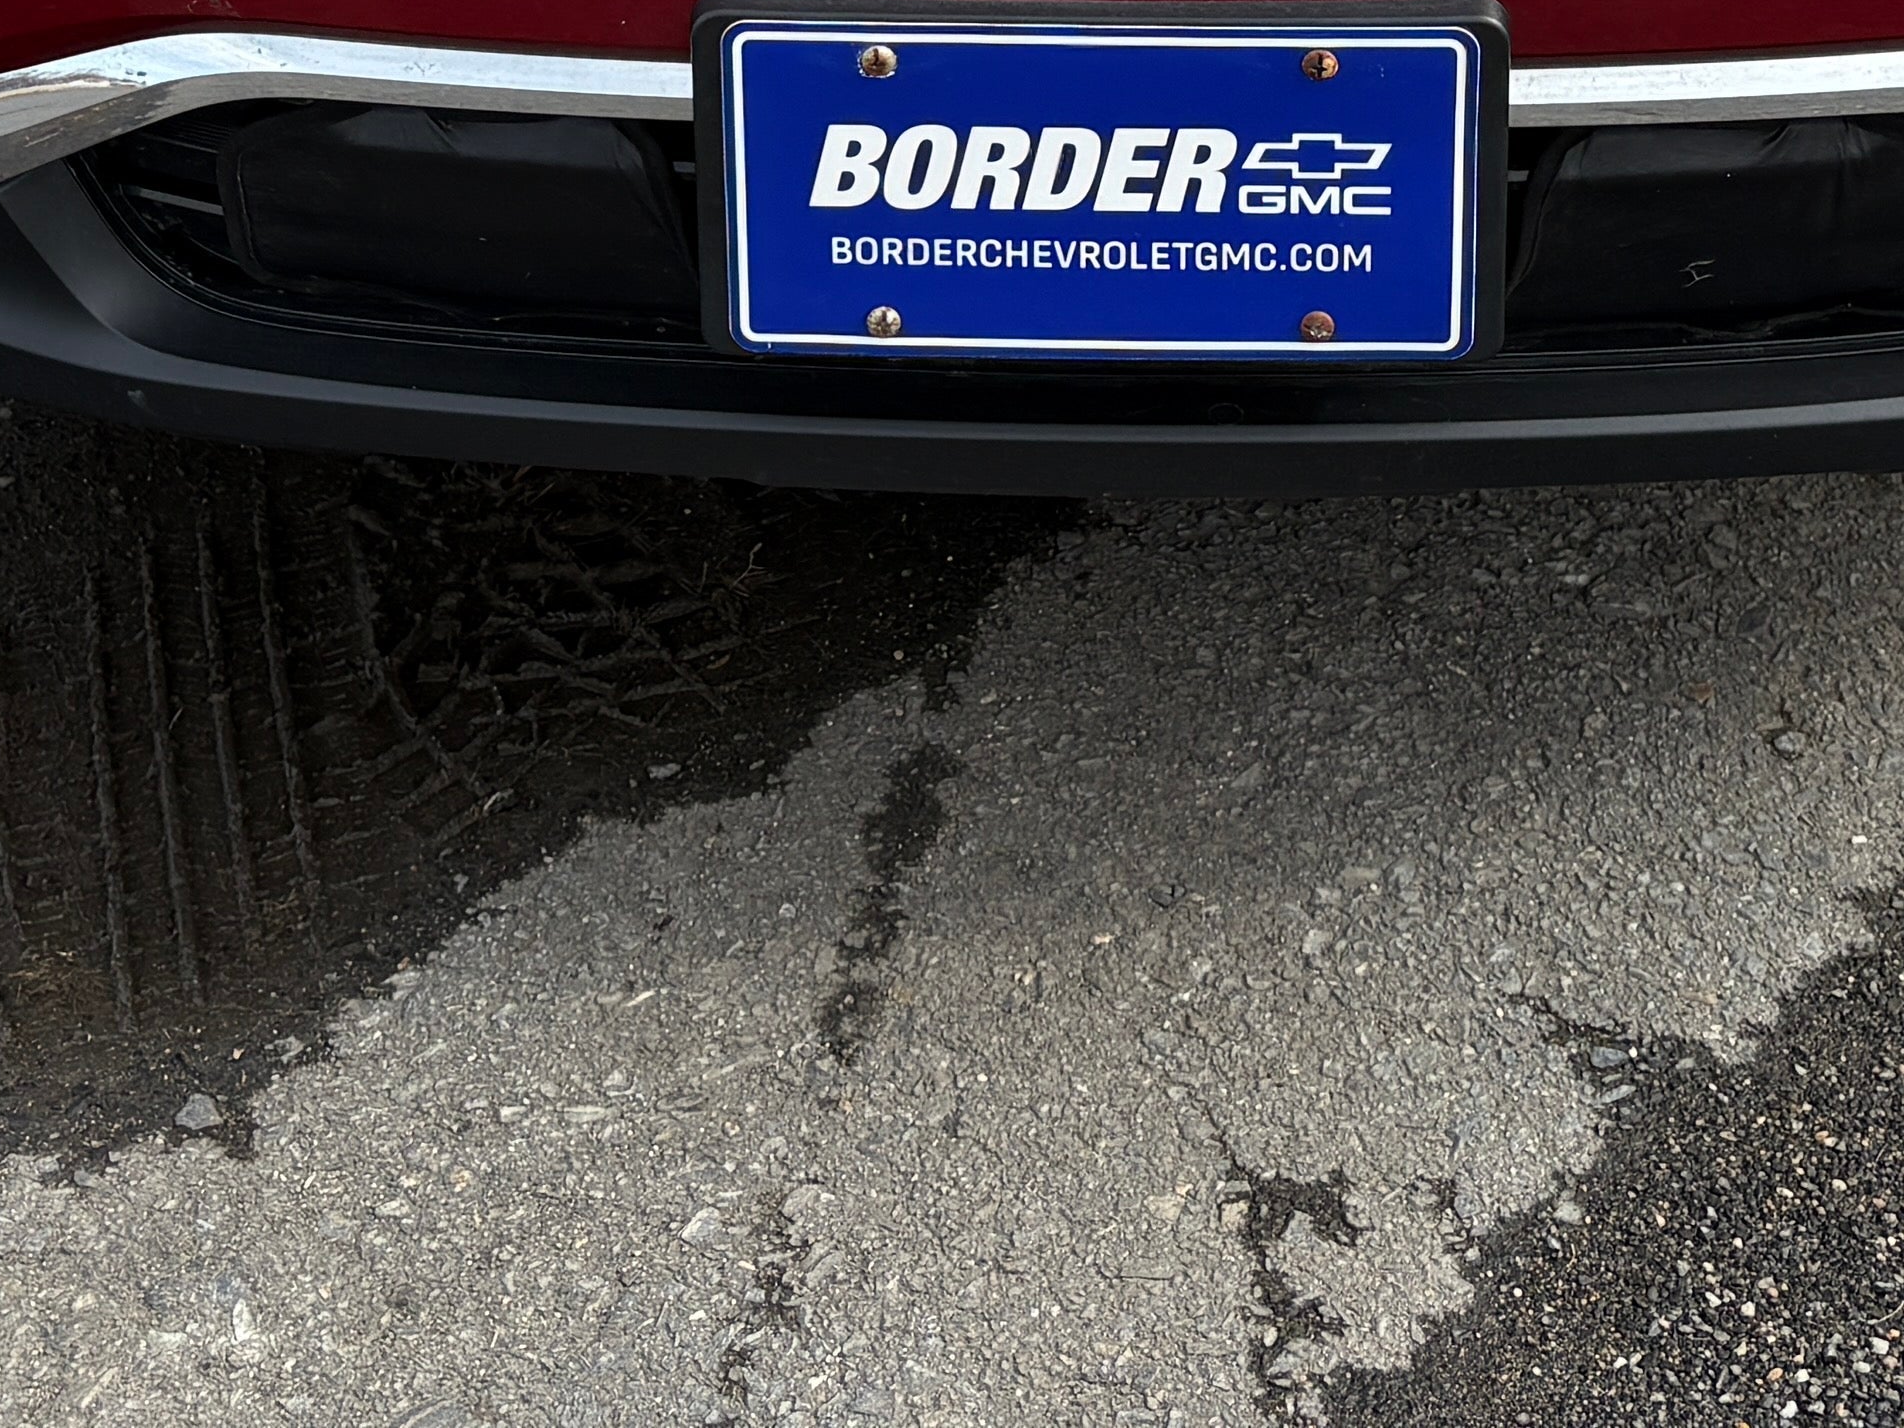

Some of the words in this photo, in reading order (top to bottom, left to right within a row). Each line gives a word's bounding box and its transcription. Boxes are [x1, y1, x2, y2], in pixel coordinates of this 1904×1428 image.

[808, 123, 1239, 214] BORDER
[1237, 184, 1393, 217] GMC
[830, 235, 1374, 273] BORDERCHEVROLETGMC.COM
